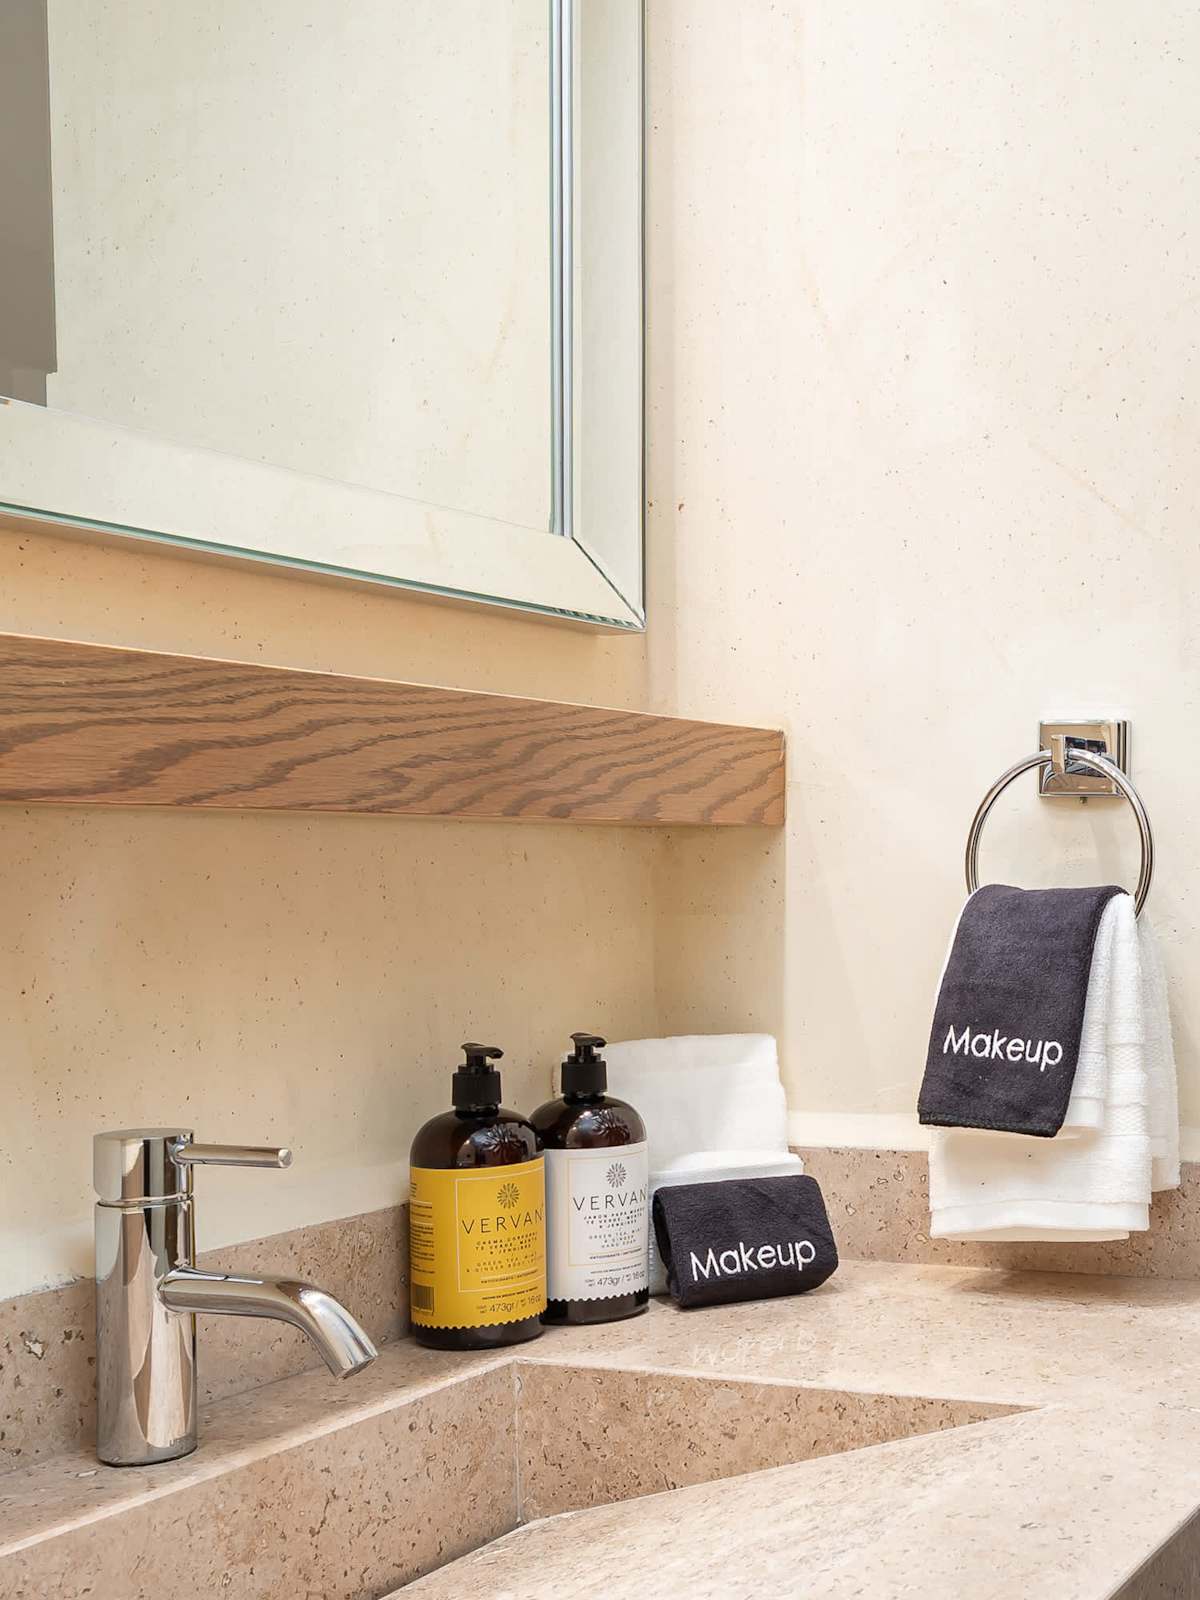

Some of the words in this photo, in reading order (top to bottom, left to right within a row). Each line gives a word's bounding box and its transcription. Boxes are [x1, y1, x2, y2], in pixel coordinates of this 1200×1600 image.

[943, 1024, 1063, 1072] Makeup
[573, 1189, 646, 1211] VERVAN
[462, 1208, 544, 1234] VERVAN
[690, 1239, 817, 1282] Makeup
